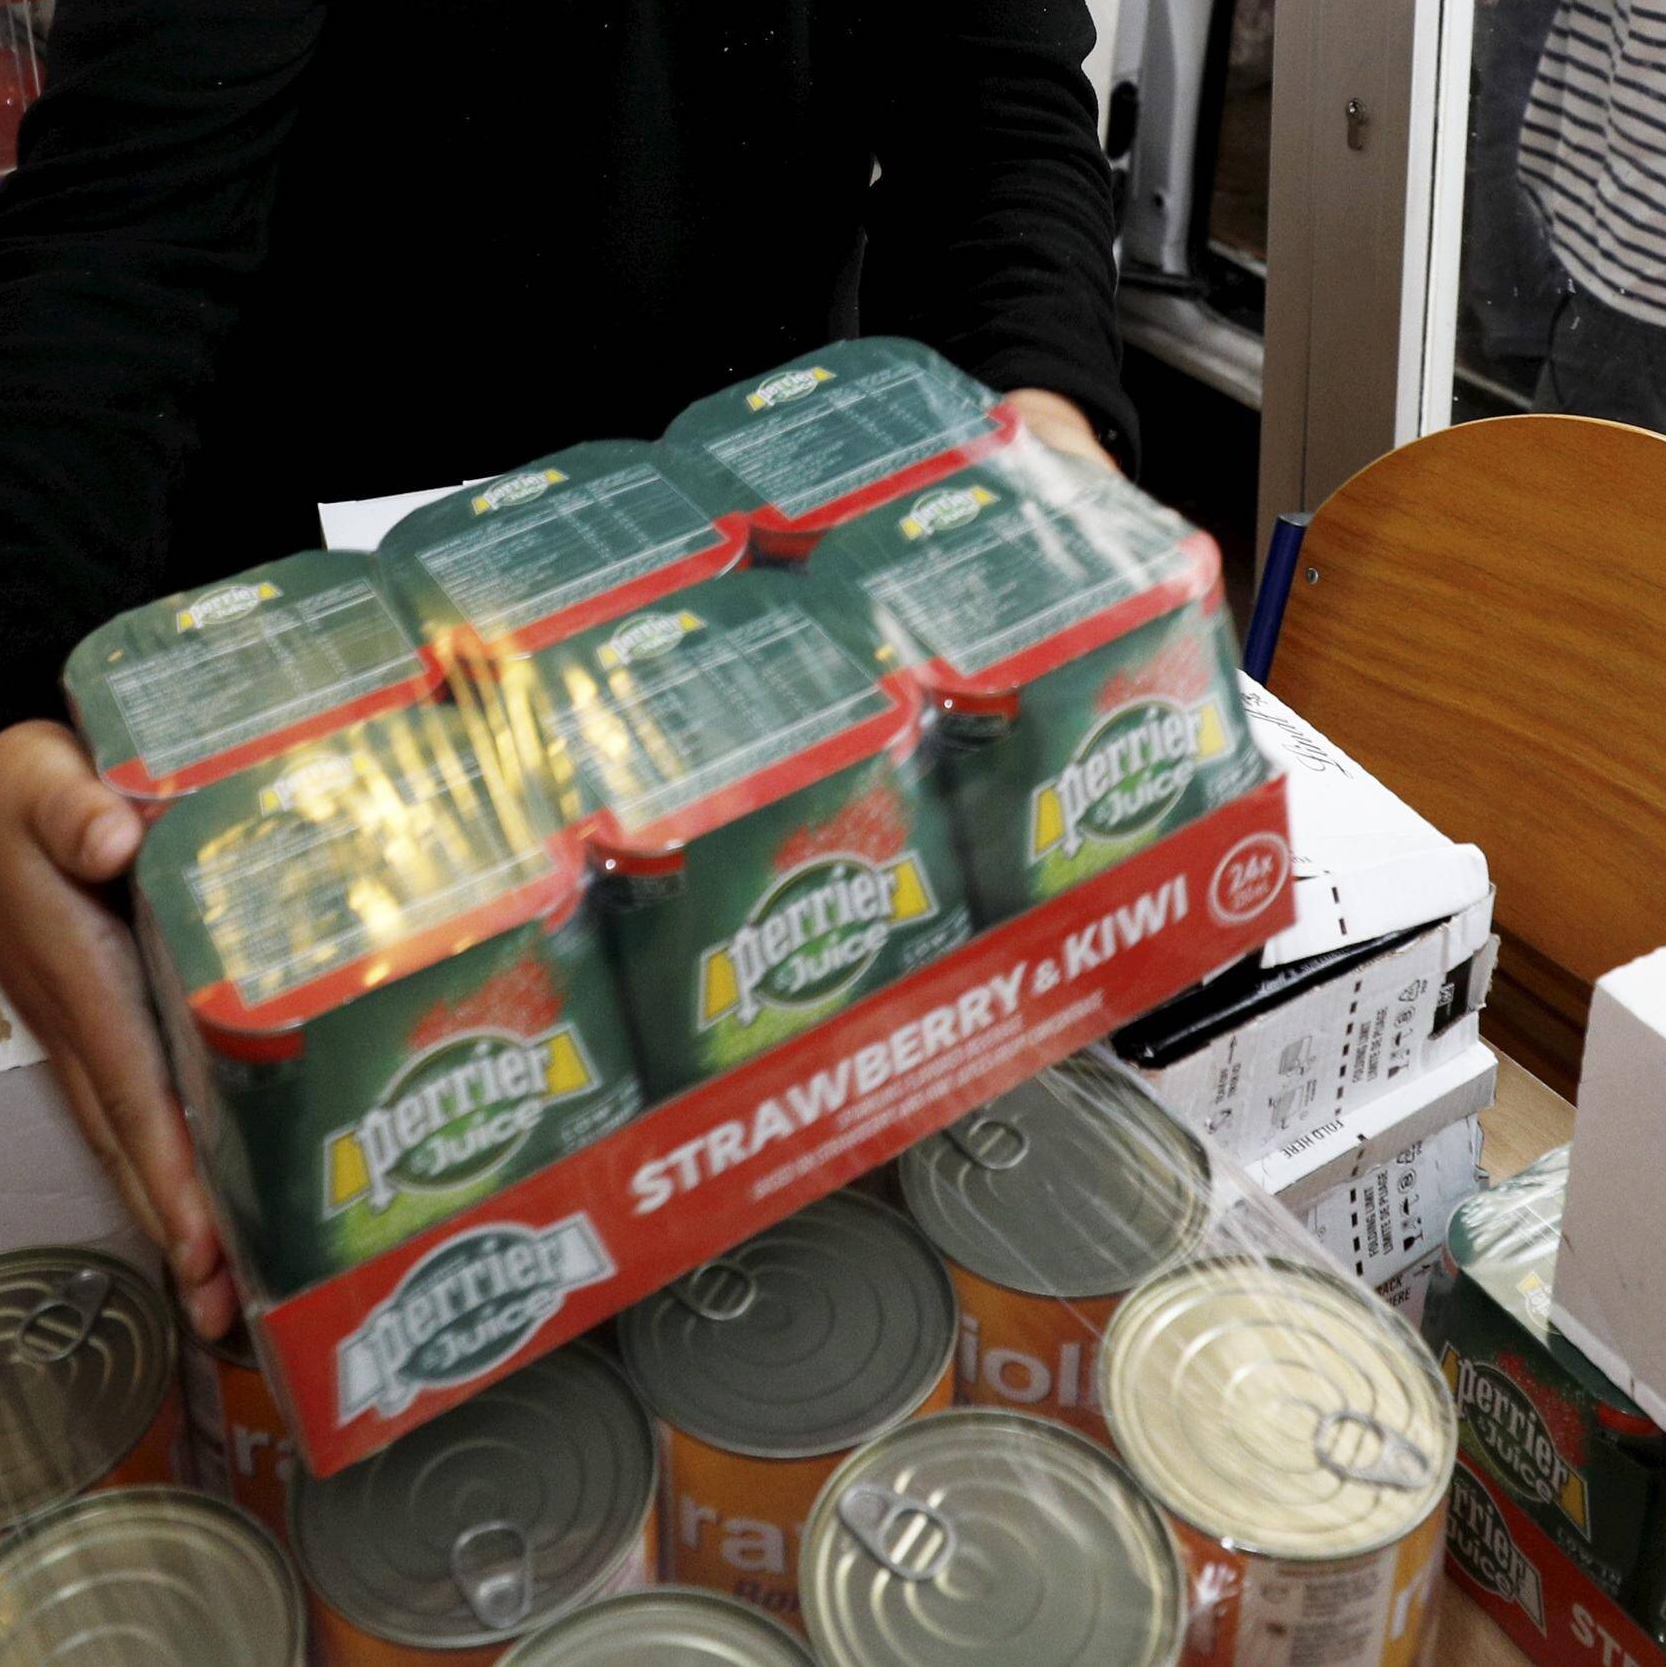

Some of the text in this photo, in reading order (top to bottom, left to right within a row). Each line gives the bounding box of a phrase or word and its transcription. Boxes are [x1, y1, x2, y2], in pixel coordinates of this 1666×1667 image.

[1052, 705, 1202, 860] perrier
[727, 864, 898, 1027] perrier
[784, 920, 889, 993] Juice
[630, 961, 1028, 1215] STRAWBERRY
[1032, 958, 1061, 994] &
[1062, 873, 1190, 983] KIWI
[353, 1039, 551, 1216] perrier
[427, 1099, 544, 1176] Juice
[1282, 1118, 1345, 1160] FOLD HERE
[1363, 1185, 1379, 1257] FOLDING LIMIT
[1379, 1205, 1389, 1219] DE
[1380, 1218, 1393, 1255] LIMITE
[371, 1237, 563, 1411] perrier
[1457, 1355, 1569, 1498] perrier
[1485, 1424, 1553, 1505] Juice
